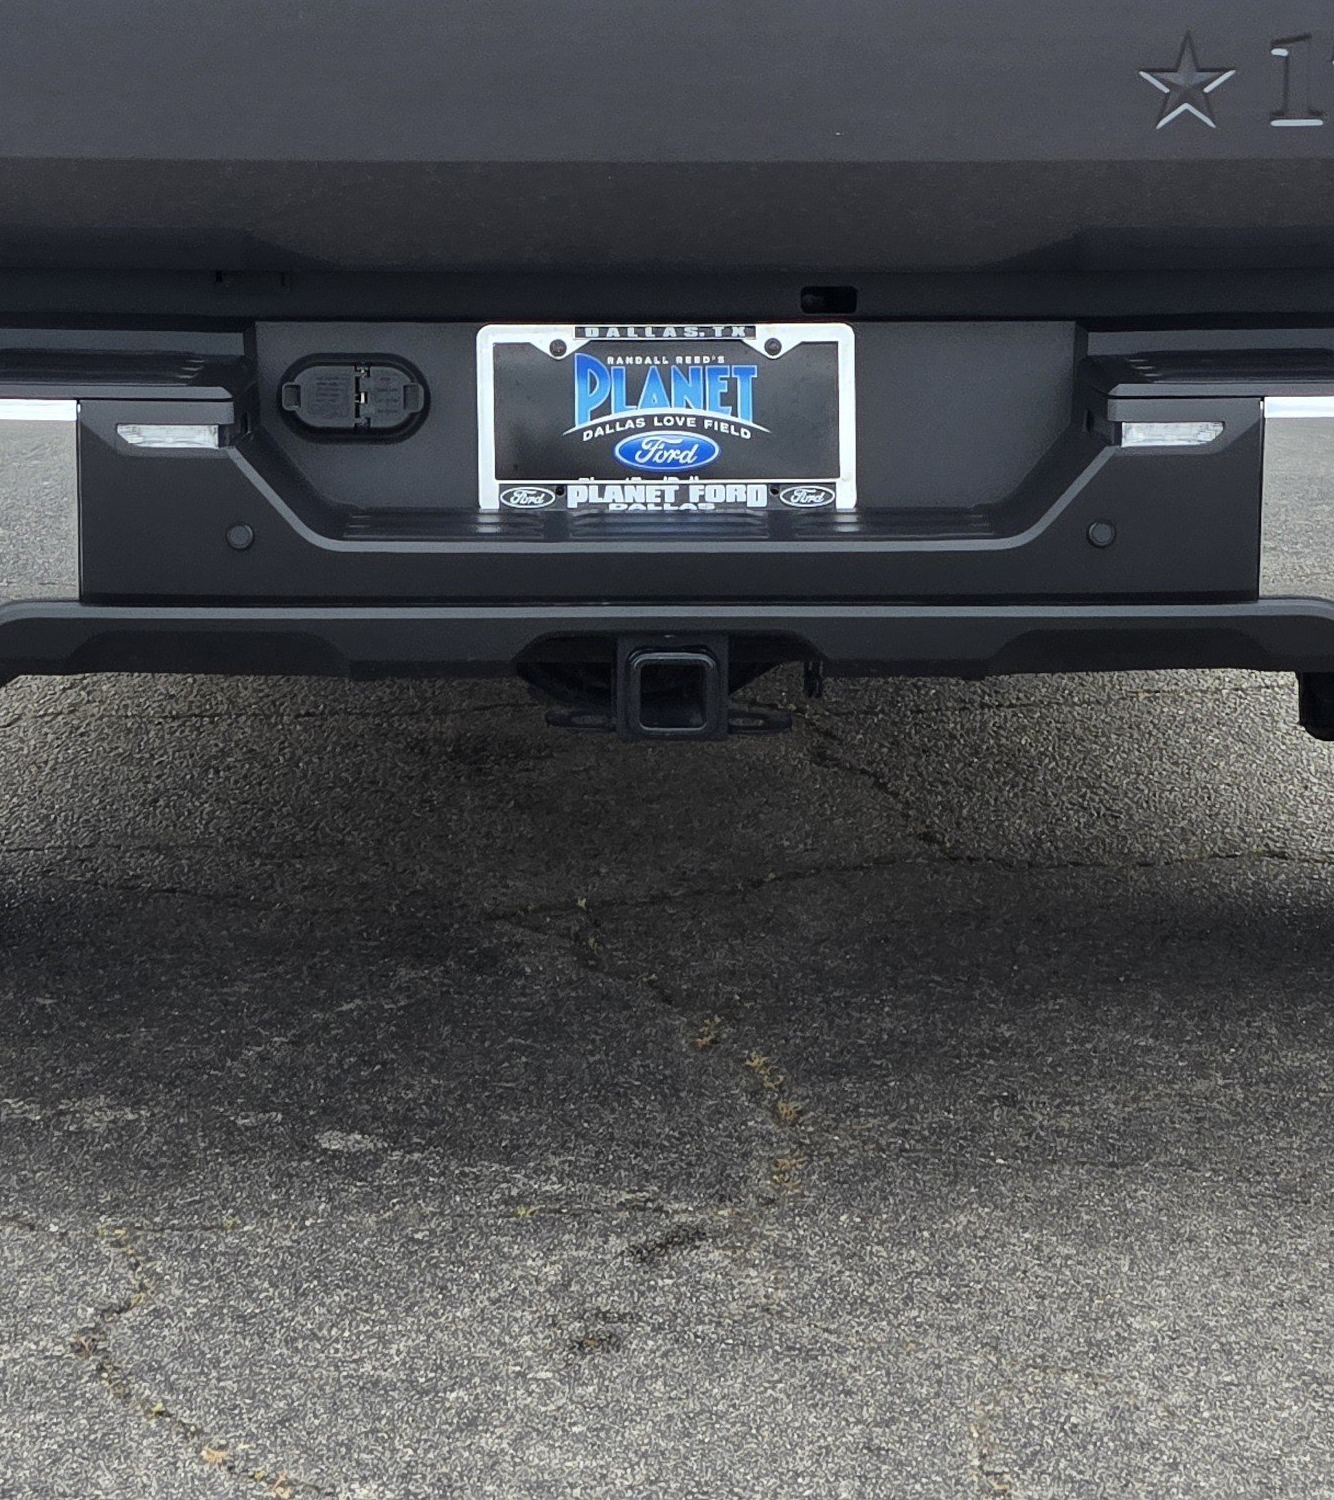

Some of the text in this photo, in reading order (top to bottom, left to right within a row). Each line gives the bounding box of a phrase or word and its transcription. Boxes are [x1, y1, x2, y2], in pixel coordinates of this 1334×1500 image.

[713, 326, 746, 337] TX
[607, 355, 669, 365] RANDALL
[575, 353, 758, 427] PLANET
[582, 416, 752, 441] DALLAS LOVE FIELD
[634, 436, 699, 464] Ford
[509, 490, 546, 504] Ford
[567, 484, 768, 509] PLANET FORD
[790, 489, 826, 503] Ford
